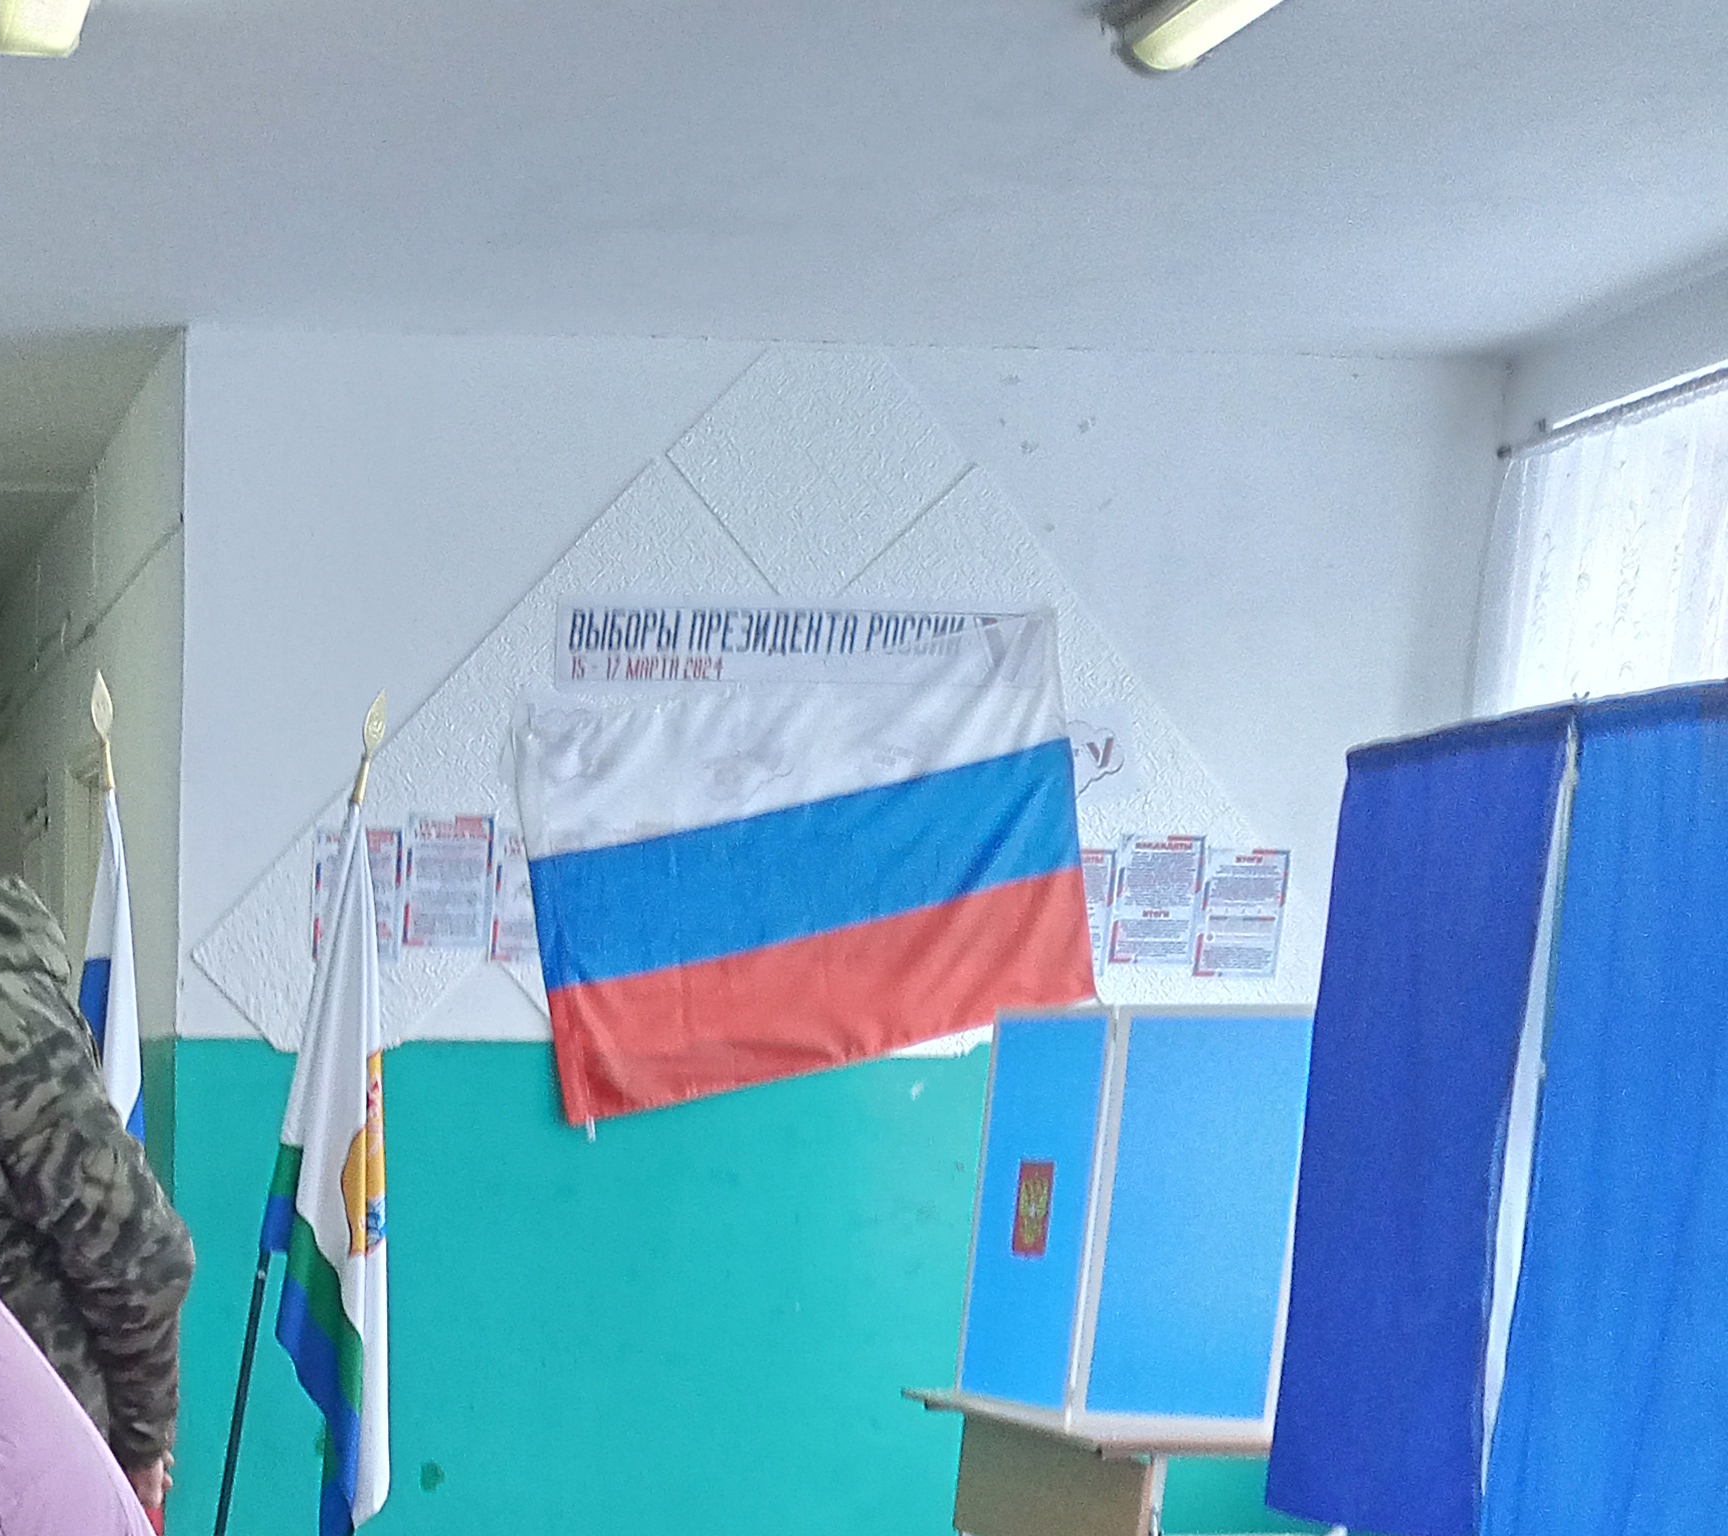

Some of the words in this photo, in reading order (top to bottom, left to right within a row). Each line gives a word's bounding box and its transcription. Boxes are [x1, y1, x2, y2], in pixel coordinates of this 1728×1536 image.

[569, 608, 681, 652] ВЫБОРЫ
[688, 609, 858, 655] ПРЕЗИДЕНТА
[571, 655, 585, 680] 15
[606, 655, 620, 680] 17
[626, 655, 679, 680] МАРТА
[683, 655, 723, 680] 2024
